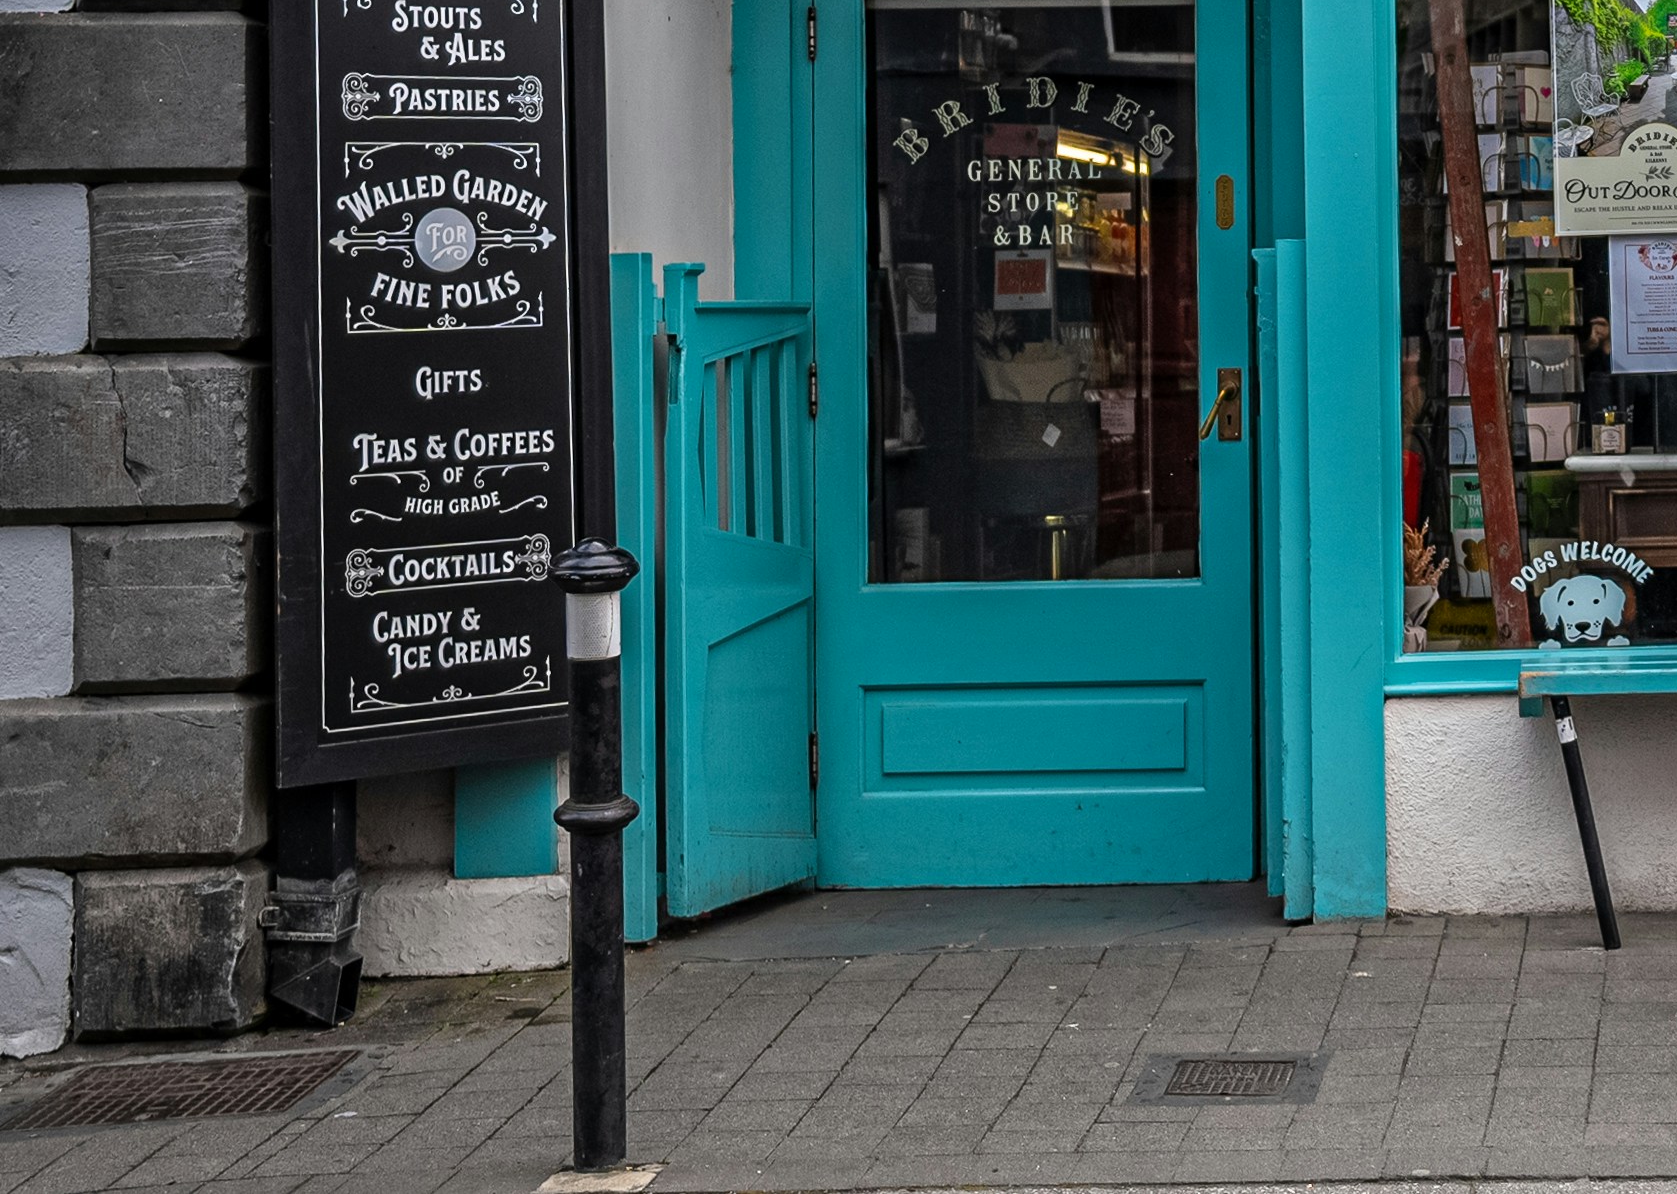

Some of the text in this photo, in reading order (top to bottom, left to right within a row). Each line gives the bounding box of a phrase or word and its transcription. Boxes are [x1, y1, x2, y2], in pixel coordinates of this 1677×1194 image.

[391, 0, 482, 32] STOUTS
[420, 32, 506, 65] & ALES
[389, 82, 500, 115] PASTRIES
[893, 76, 1175, 165] BRIDIE'S
[967, 158, 1102, 181] GENERAL
[337, 169, 548, 224] WALLED GARDEN
[987, 191, 1079, 213] STORE
[426, 222, 467, 252] FOR
[370, 270, 522, 309] FINE FOLKS
[415, 366, 483, 400] GIFTS
[352, 428, 555, 472] TEAS & COFFEES
[442, 466, 464, 484] OF
[405, 490, 501, 515] HIGH GRADE
[387, 550, 515, 586] COCKTAILS
[1510, 541, 1655, 593] DOGS WELCOME
[373, 607, 481, 642] CANDY &
[387, 635, 532, 679] ICE CREAMS
